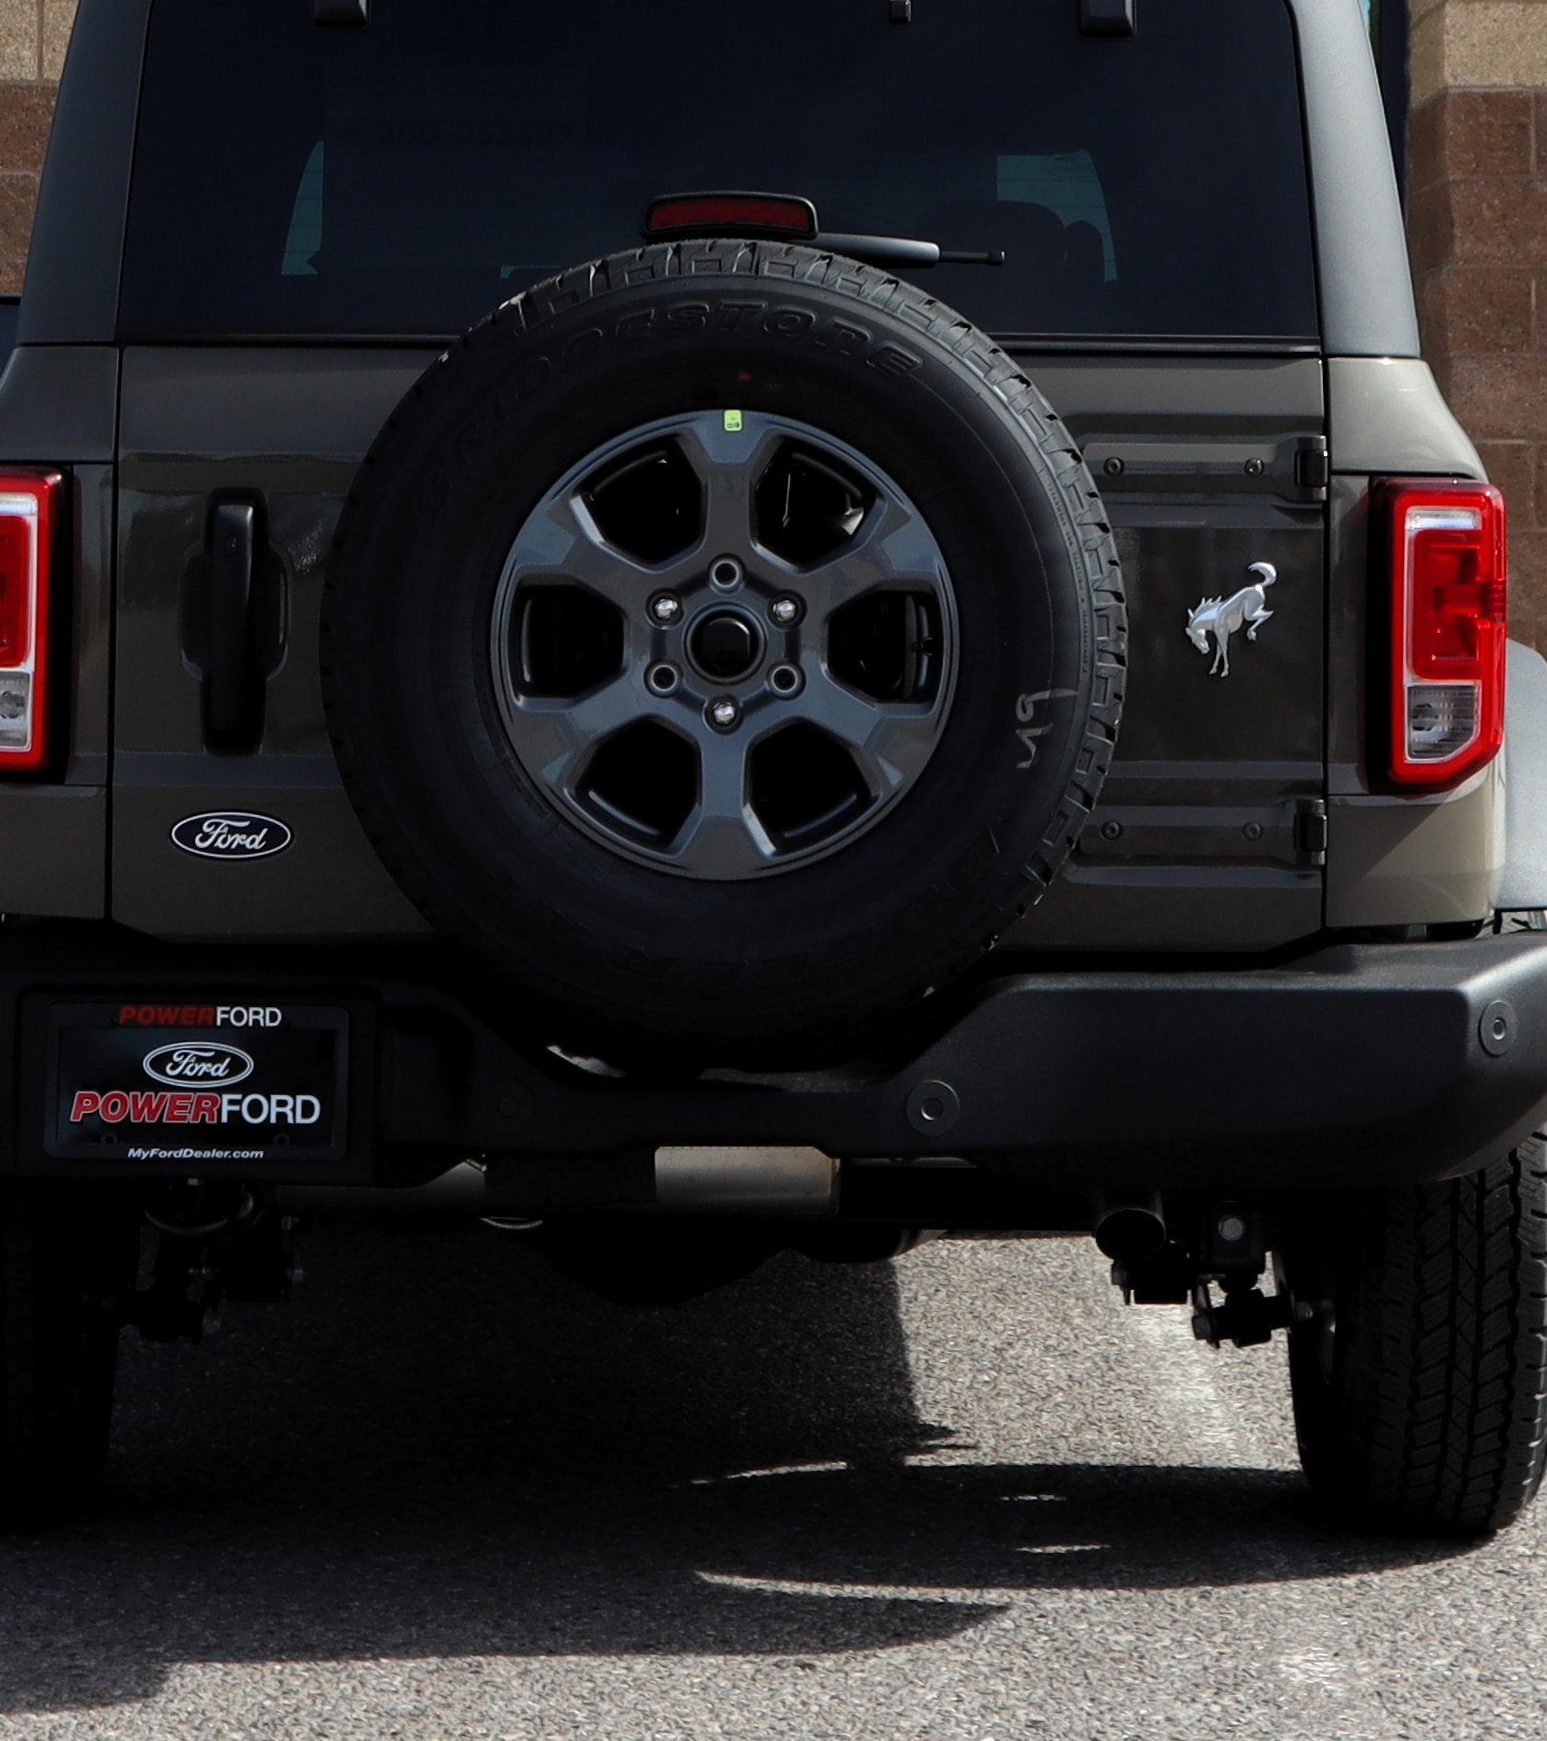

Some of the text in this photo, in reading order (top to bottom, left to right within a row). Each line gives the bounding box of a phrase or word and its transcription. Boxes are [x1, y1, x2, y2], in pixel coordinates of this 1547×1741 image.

[194, 818, 269, 850] Ford
[118, 1005, 283, 1028] POWERFORD
[165, 1049, 232, 1078] Ford
[69, 1091, 321, 1125] POWERFORD
[127, 1147, 265, 1160] MyFordDealer.com
